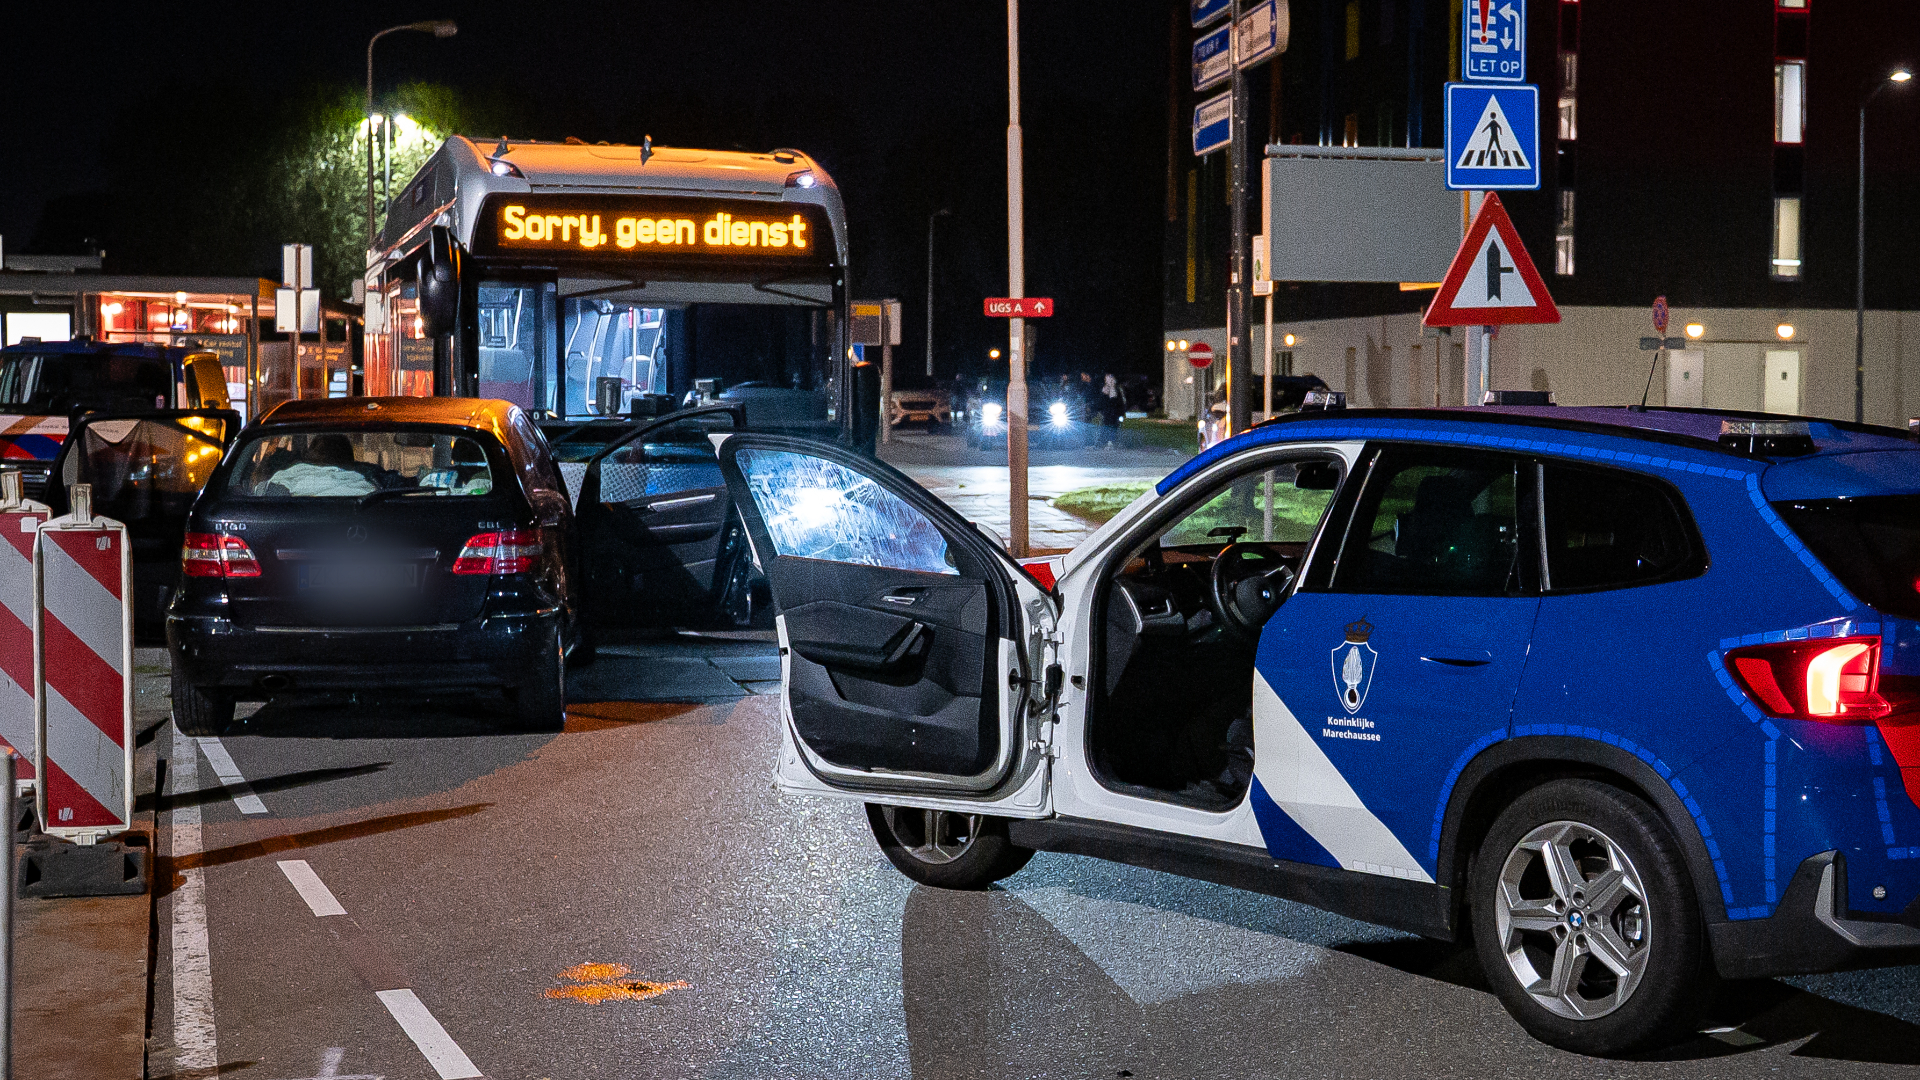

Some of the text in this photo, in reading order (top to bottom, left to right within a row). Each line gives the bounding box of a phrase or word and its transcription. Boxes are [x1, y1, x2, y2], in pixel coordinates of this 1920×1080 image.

[1470, 59, 1520, 74] LET OP
[503, 204, 807, 249] Sorry, geen dienst
[989, 303, 1023, 313] UGS A
[1327, 716, 1375, 730] Koninklijke
[1322, 728, 1381, 742] Marechaussee
